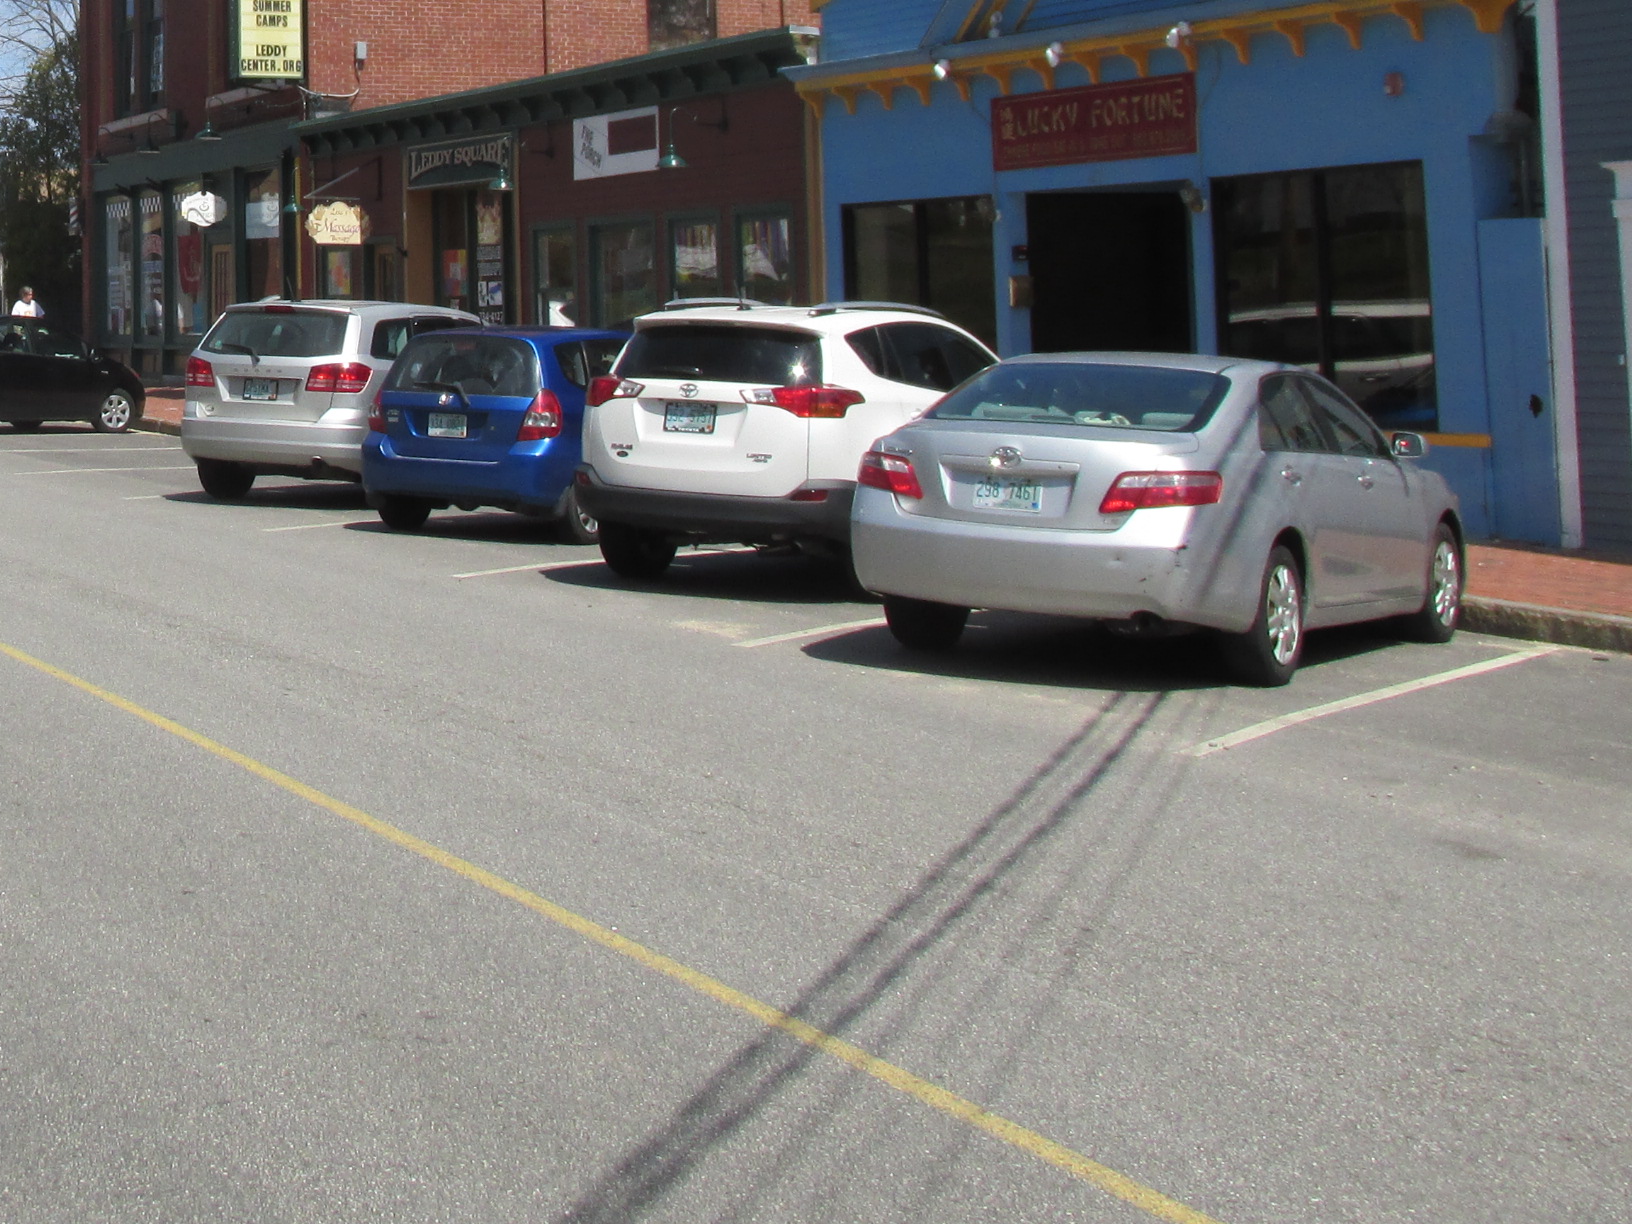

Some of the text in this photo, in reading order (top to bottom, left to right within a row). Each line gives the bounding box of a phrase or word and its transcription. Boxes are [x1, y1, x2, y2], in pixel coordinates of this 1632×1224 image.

[253, 0, 292, 13] SUMMER
[256, 14, 288, 27] CAMPS
[256, 44, 287, 58] LEDDY
[241, 59, 302, 73] CENTER.ORG
[1018, 102, 1078, 136] LUCKY
[1090, 89, 1184, 127] FORTUNE
[410, 139, 512, 181] LEDDY SQUARE
[314, 217, 360, 236] Massage
[976, 481, 1001, 498] 298
